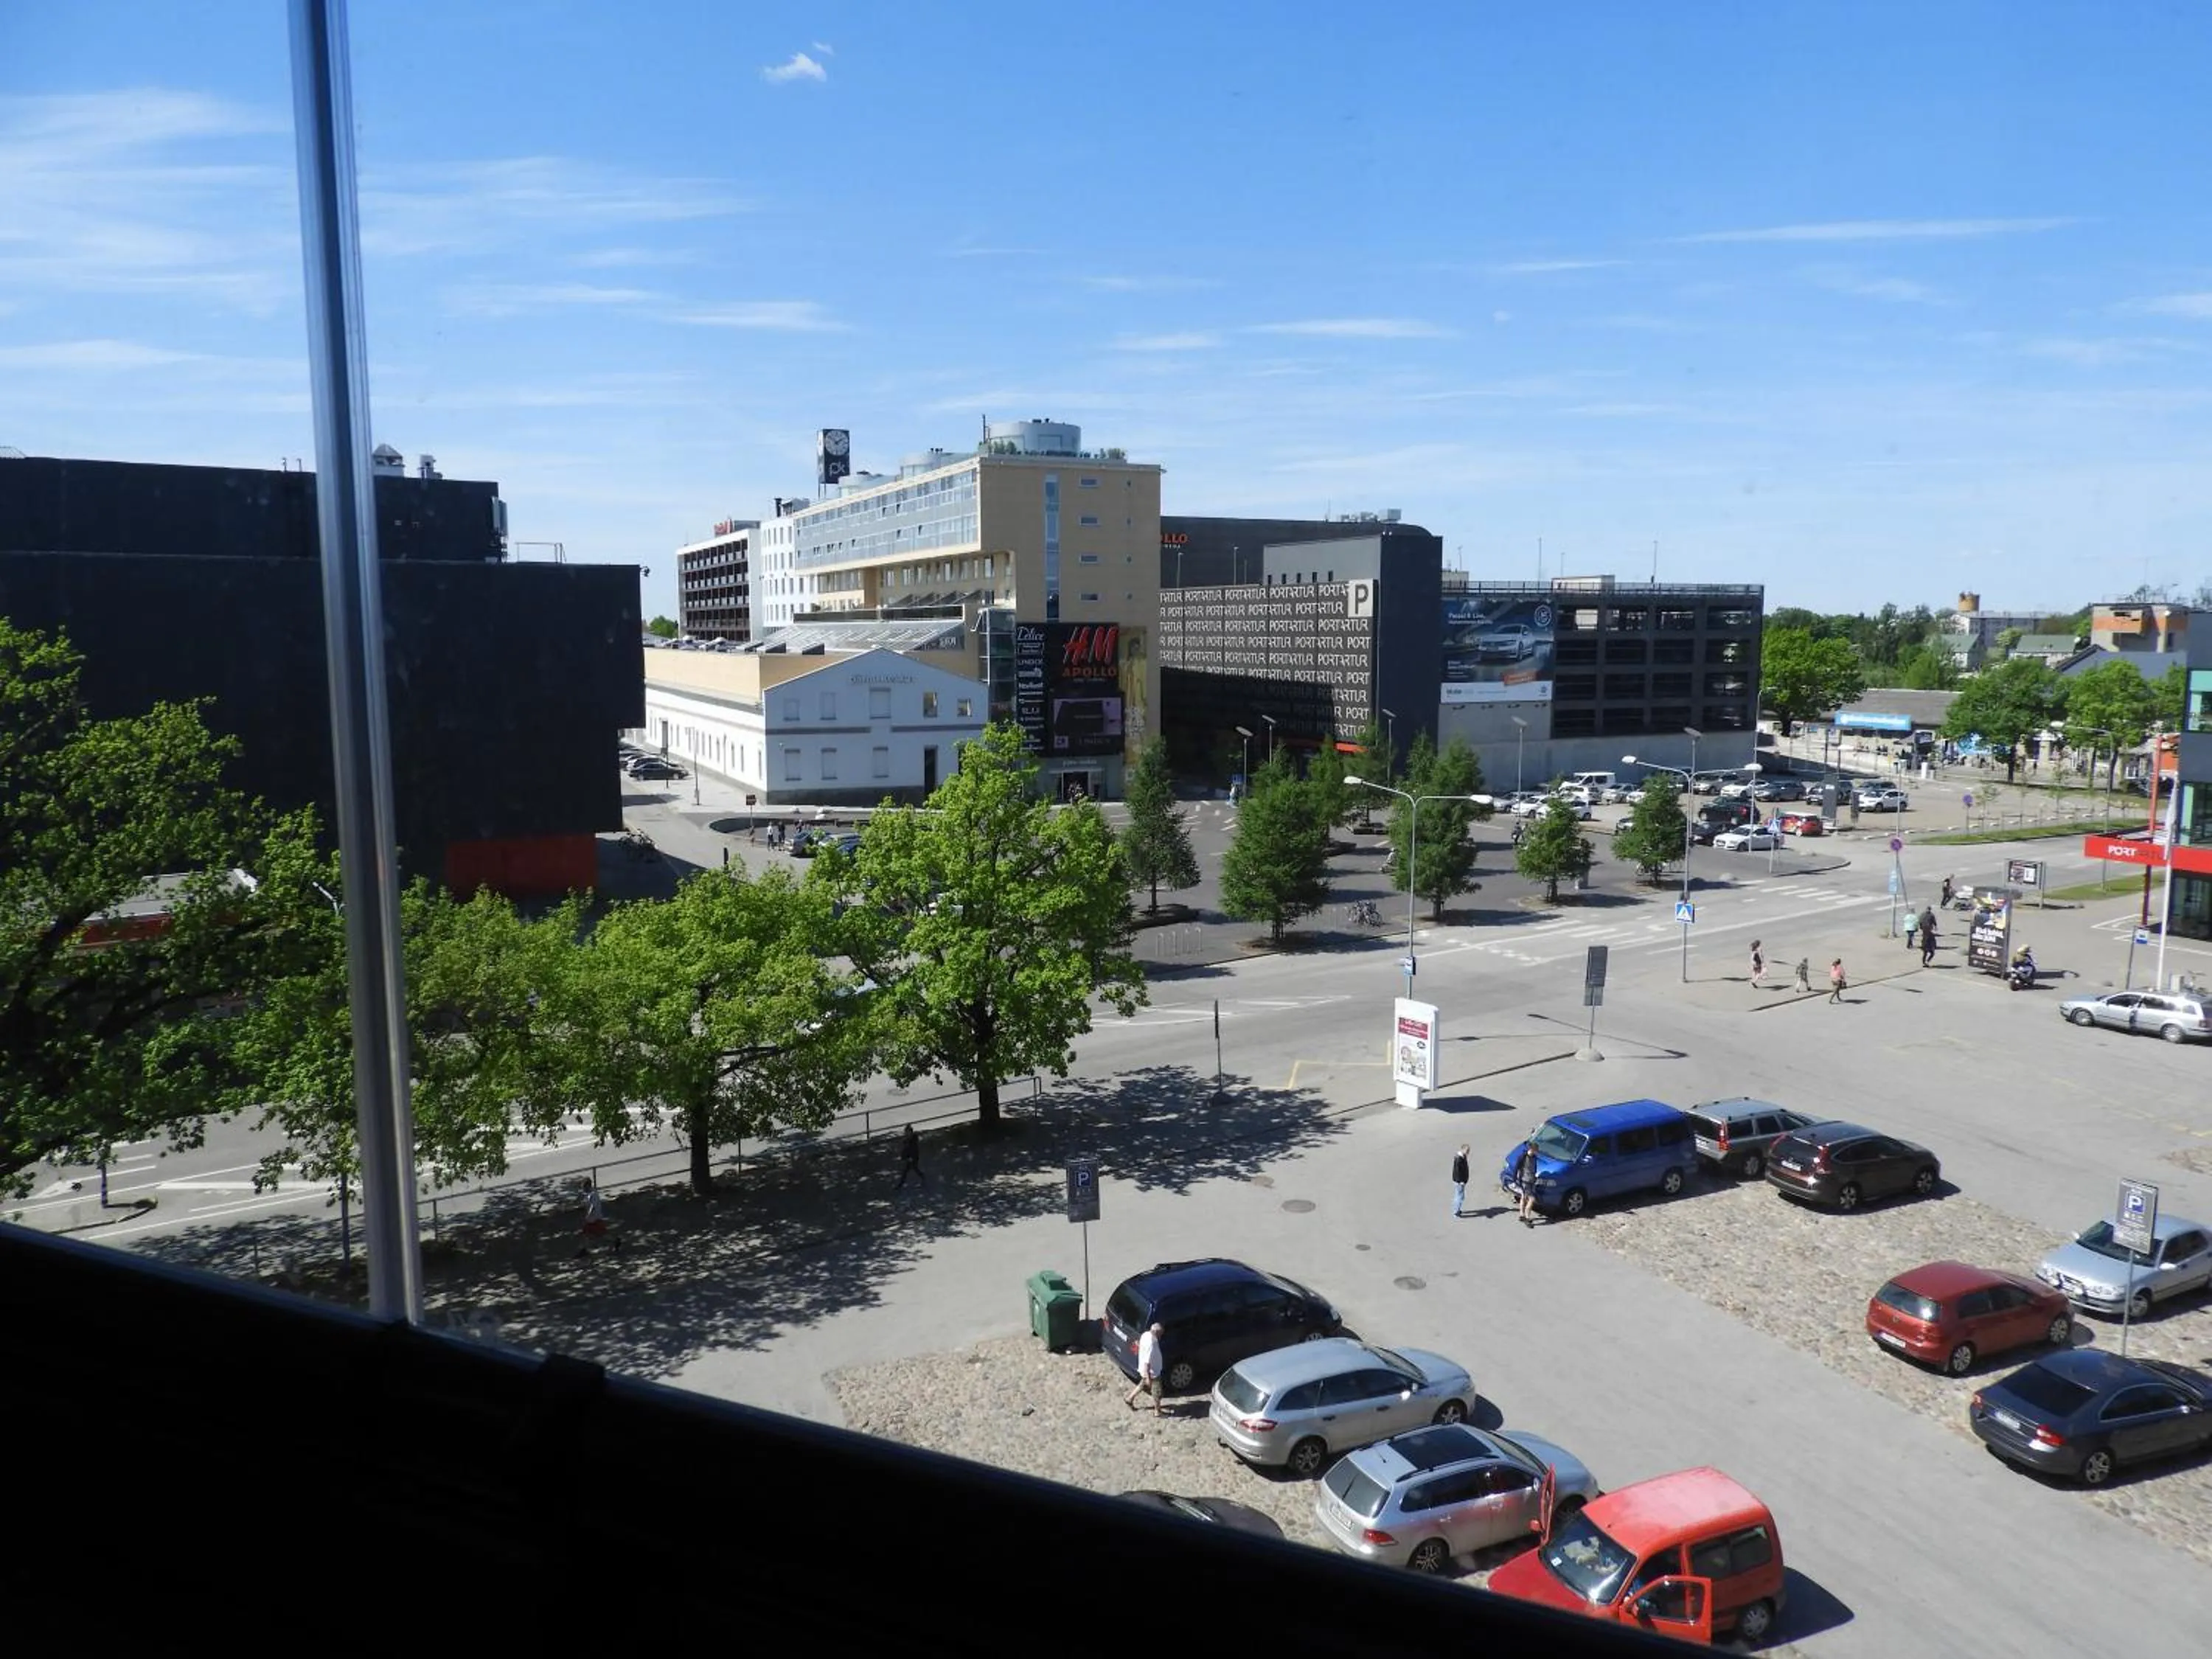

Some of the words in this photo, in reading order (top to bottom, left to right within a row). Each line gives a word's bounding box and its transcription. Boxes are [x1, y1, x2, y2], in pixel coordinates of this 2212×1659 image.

[1161, 533, 1188, 543] LLO
[1225, 588, 1267, 600] PORTARTUR
[1269, 585, 1315, 599] PORTARTUR
[1355, 583, 1369, 614] P
[1248, 603, 1292, 616] PORTARTUR
[1295, 601, 1343, 615] PORTARTUR
[1269, 620, 1315, 632] PORTARTUR
[1318, 619, 1368, 632] PORTARTUR
[1248, 636, 1292, 648] PORTARTUR
[1295, 636, 1343, 649] PORTARTUR
[1347, 636, 1371, 649] PORT
[1269, 653, 1315, 665] PORTARTUR
[1318, 653, 1368, 667] PORTARTUR
[1062, 667, 1117, 678] APOLLO
[1294, 669, 1343, 685] PORTARTUR
[1346, 672, 1371, 685] PORT
[1346, 707, 1369, 720] PORT
[2108, 845, 2137, 857] PORT
[1078, 1172, 1089, 1186] P
[2128, 1195, 2142, 1209] P
